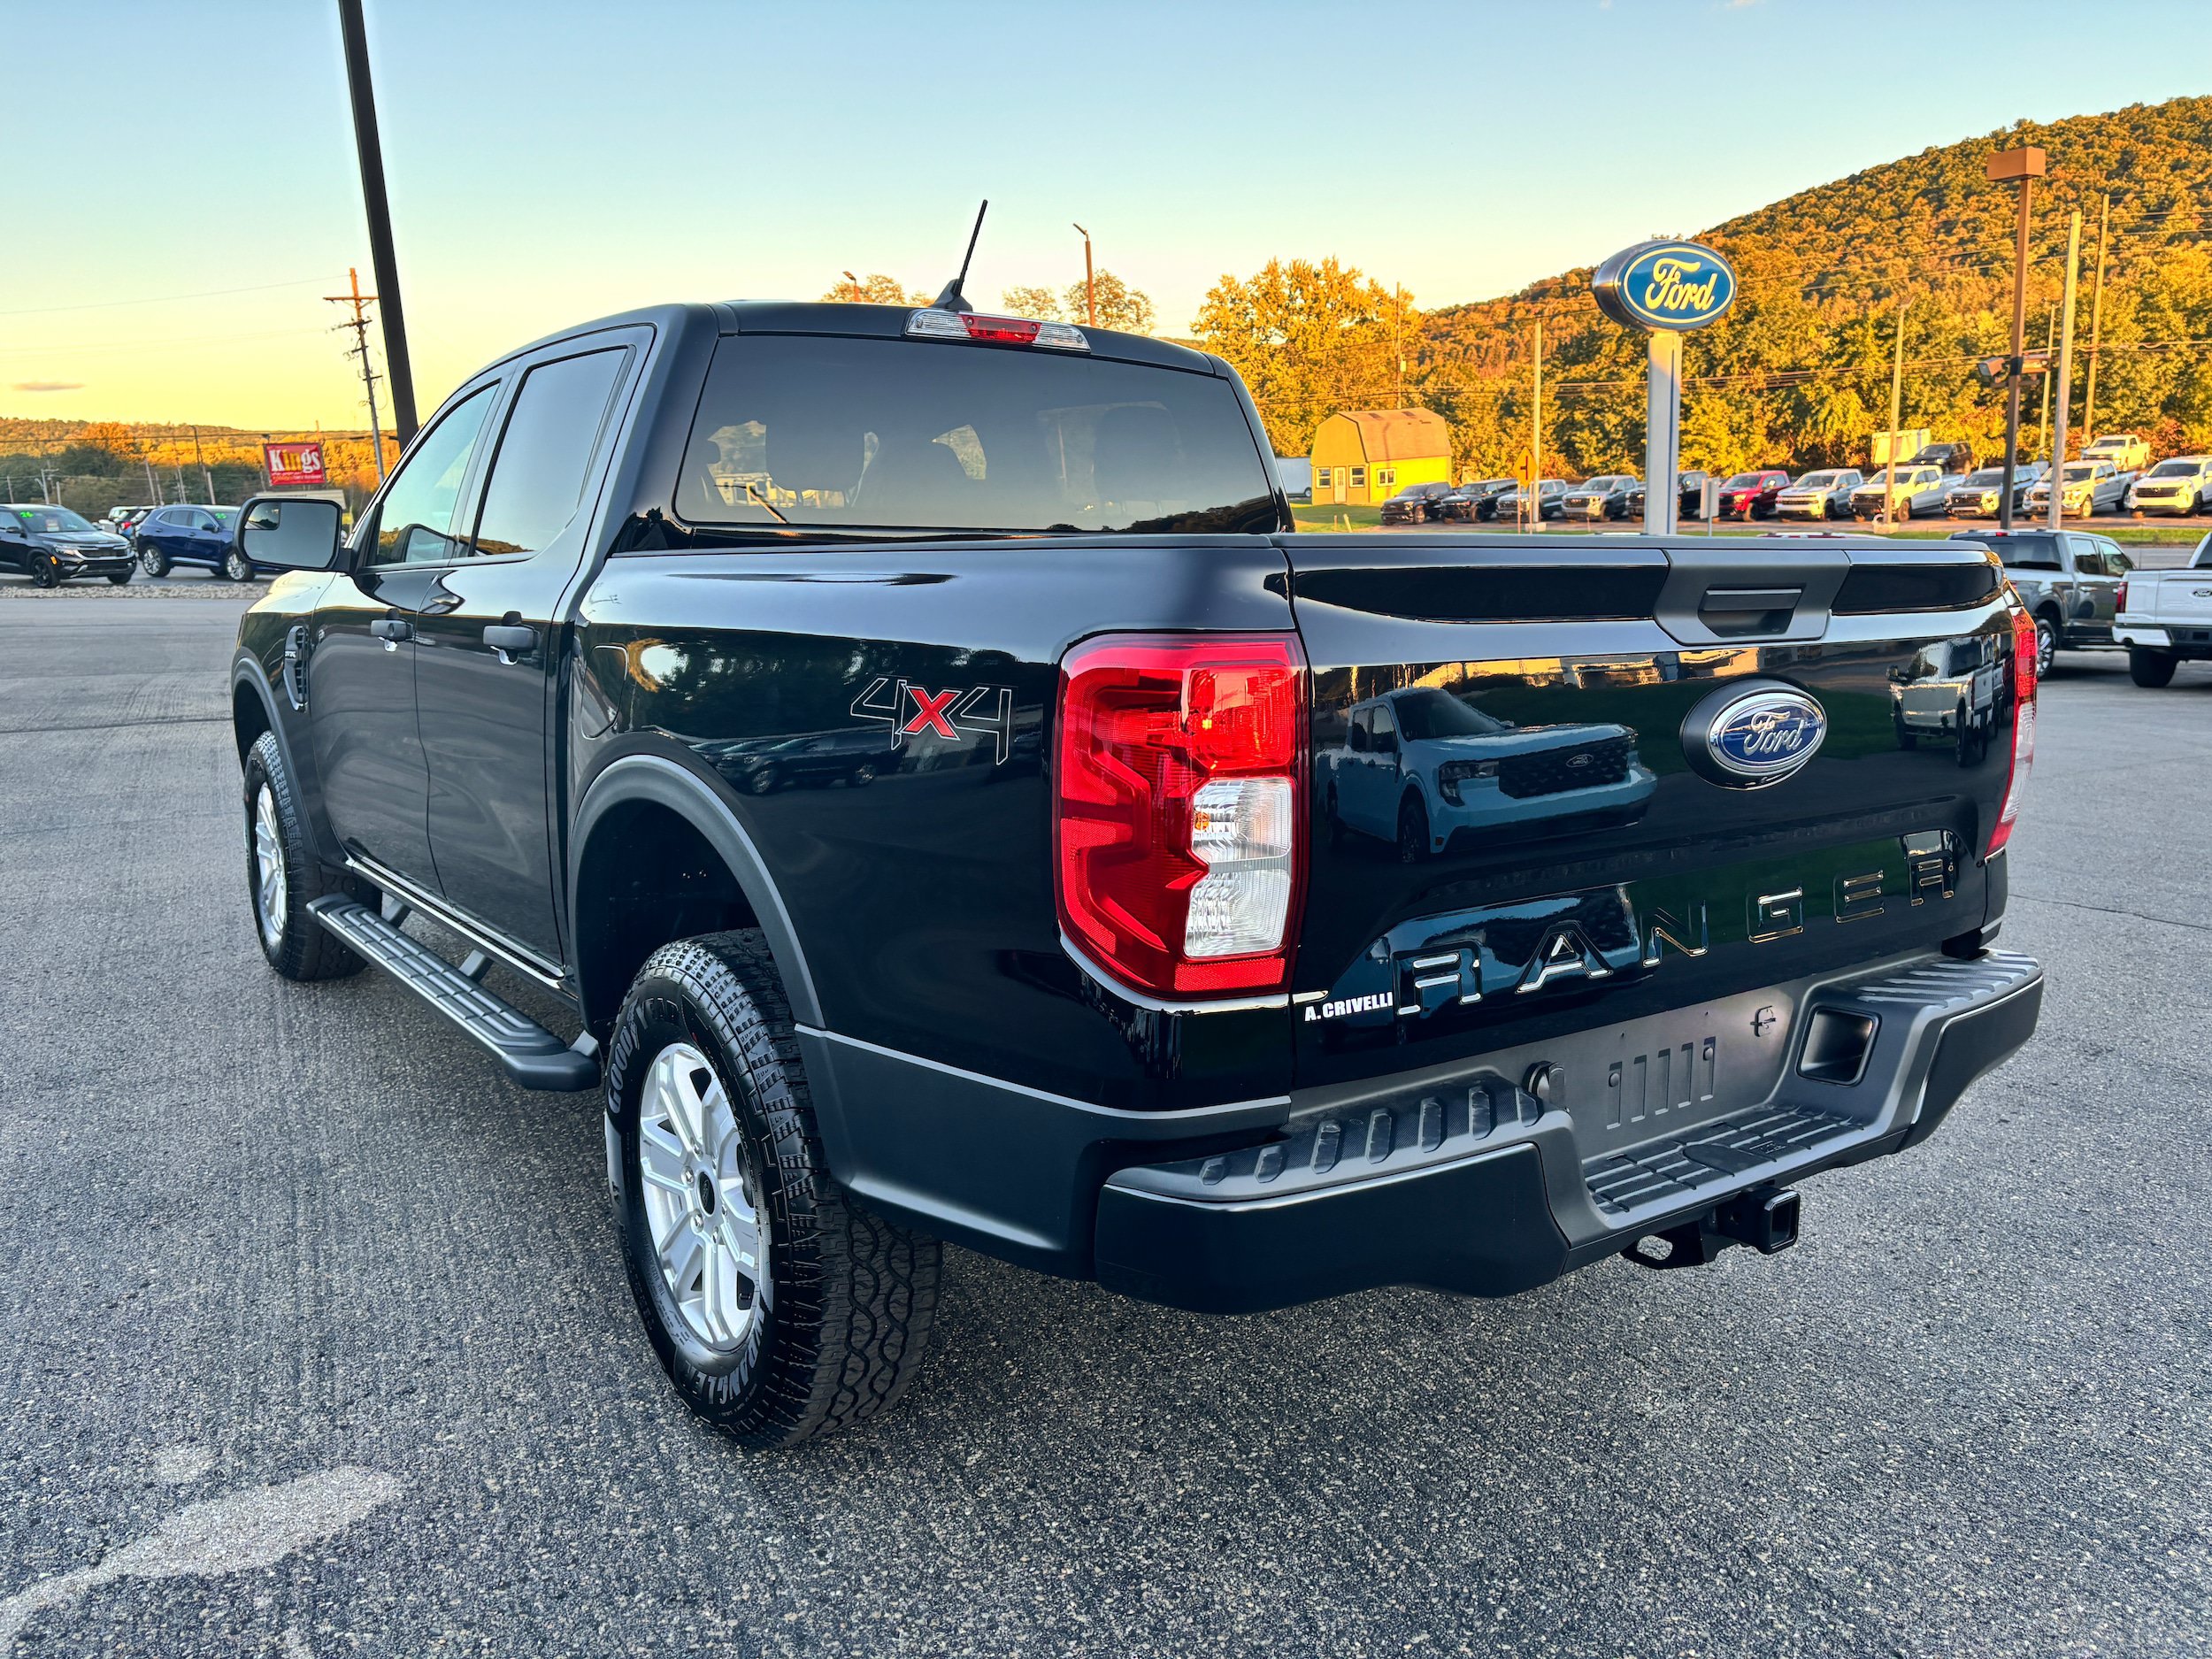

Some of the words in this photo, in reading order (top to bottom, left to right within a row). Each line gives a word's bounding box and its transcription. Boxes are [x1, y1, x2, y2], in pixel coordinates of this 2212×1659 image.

[1645, 257, 1718, 311] Ford
[269, 449, 321, 474] Kings
[1743, 710, 1804, 757] Ford
[1393, 855, 1955, 1015] RANGER
